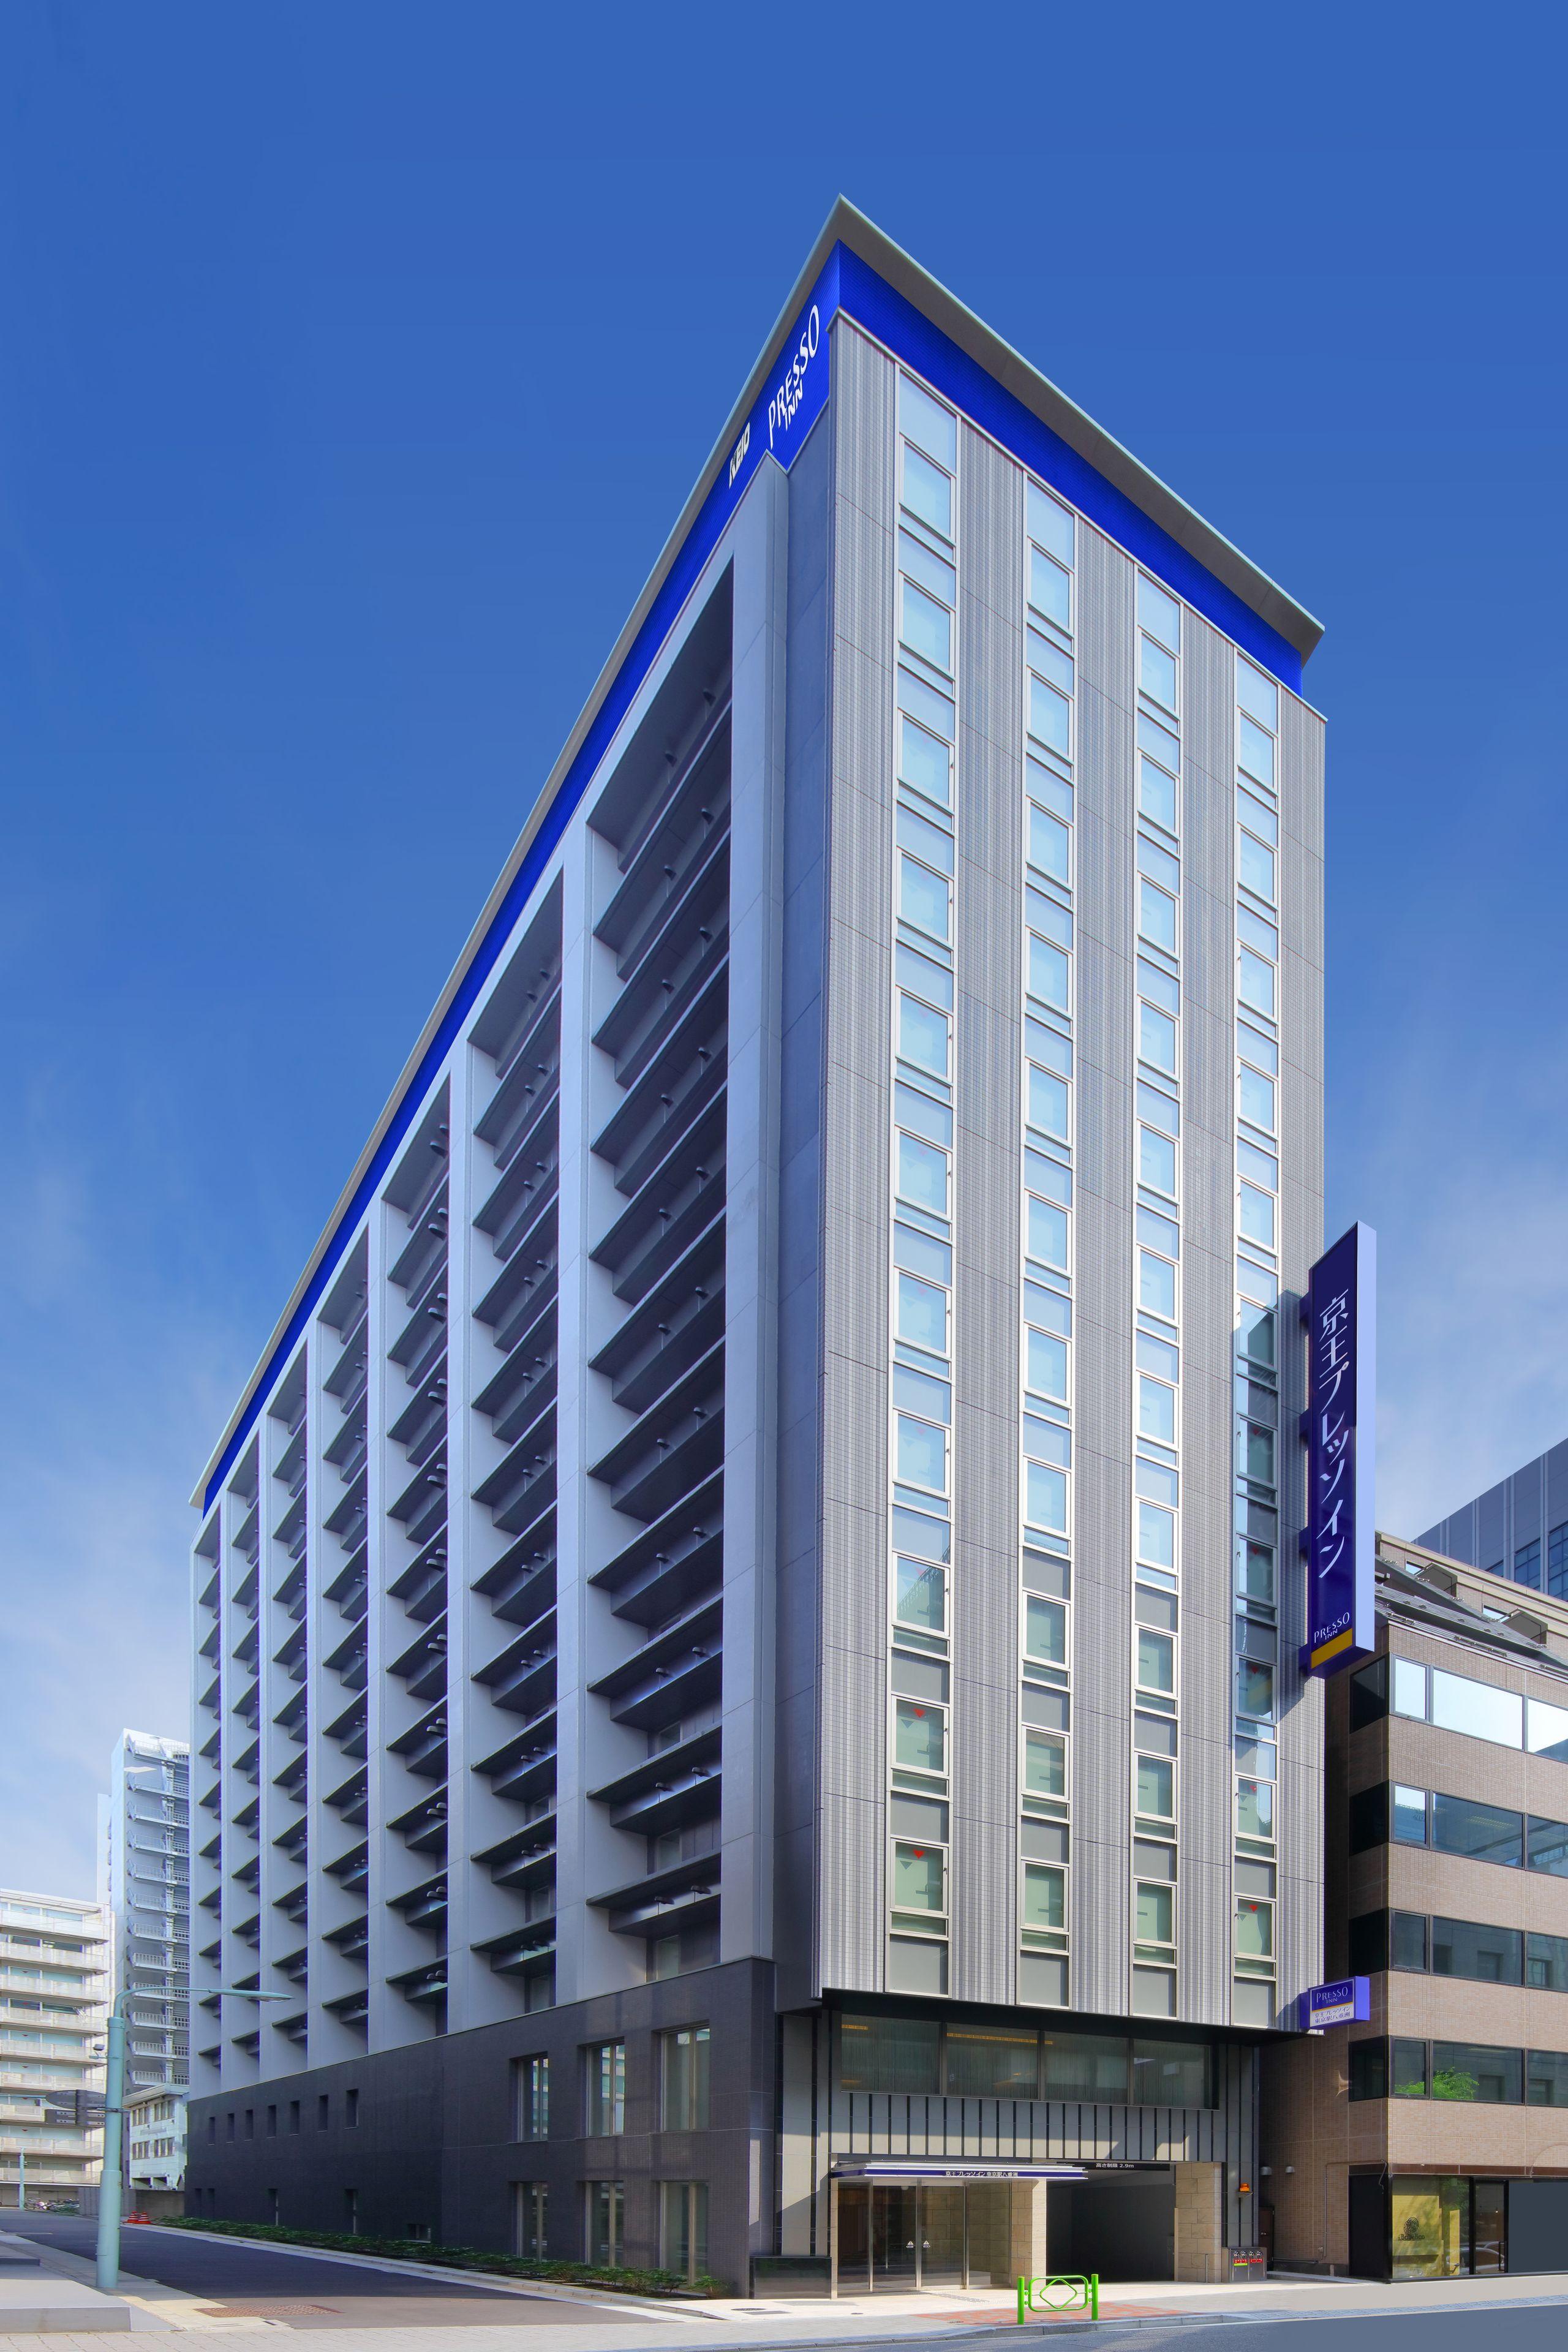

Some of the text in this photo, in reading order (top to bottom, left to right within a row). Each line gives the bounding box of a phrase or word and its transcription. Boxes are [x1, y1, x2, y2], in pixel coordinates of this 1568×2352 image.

[768, 304, 820, 450] PRESSO
[783, 379, 803, 431] INN
[1316, 1289, 1349, 1578] 京王プレッソイン
[1314, 1612, 1350, 1643] PRESSO
[1325, 1629, 1338, 1640] INN
[1316, 1986, 1348, 2003] PRESSO
